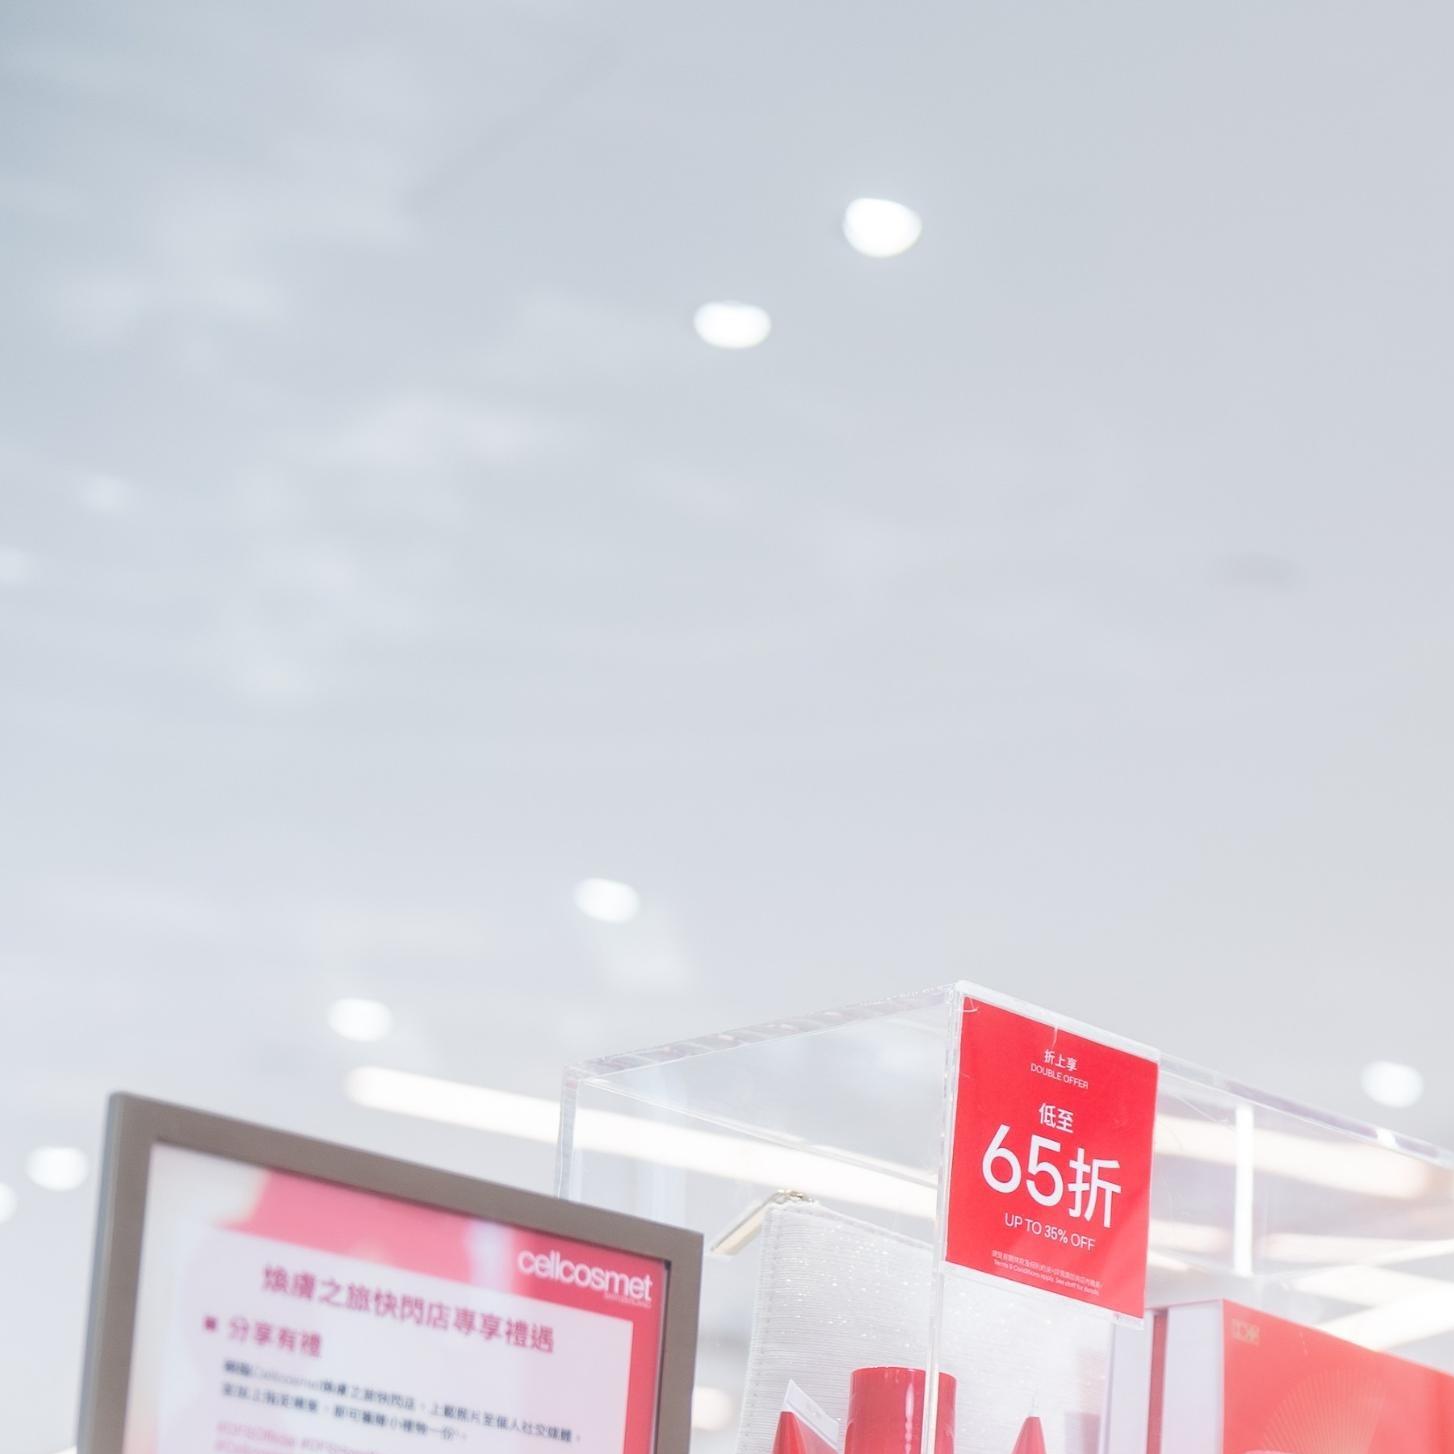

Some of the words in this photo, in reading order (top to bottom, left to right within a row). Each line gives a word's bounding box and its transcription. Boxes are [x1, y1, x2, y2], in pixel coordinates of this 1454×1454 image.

[1030, 1063, 1062, 1083] DOUBLE
[1063, 1073, 1089, 1091] OFFER
[1044, 1049, 1077, 1072] 折上享
[1038, 1103, 1074, 1133] 低至
[982, 1124, 1121, 1228] 65折
[1004, 1213, 1023, 1229] UP
[1024, 1218, 1042, 1235] TO
[1044, 1223, 1069, 1245] 35%
[1070, 1233, 1097, 1252] OFF
[516, 1249, 653, 1302] cellcosmet
[228, 1316, 322, 1358] 分享有禮
